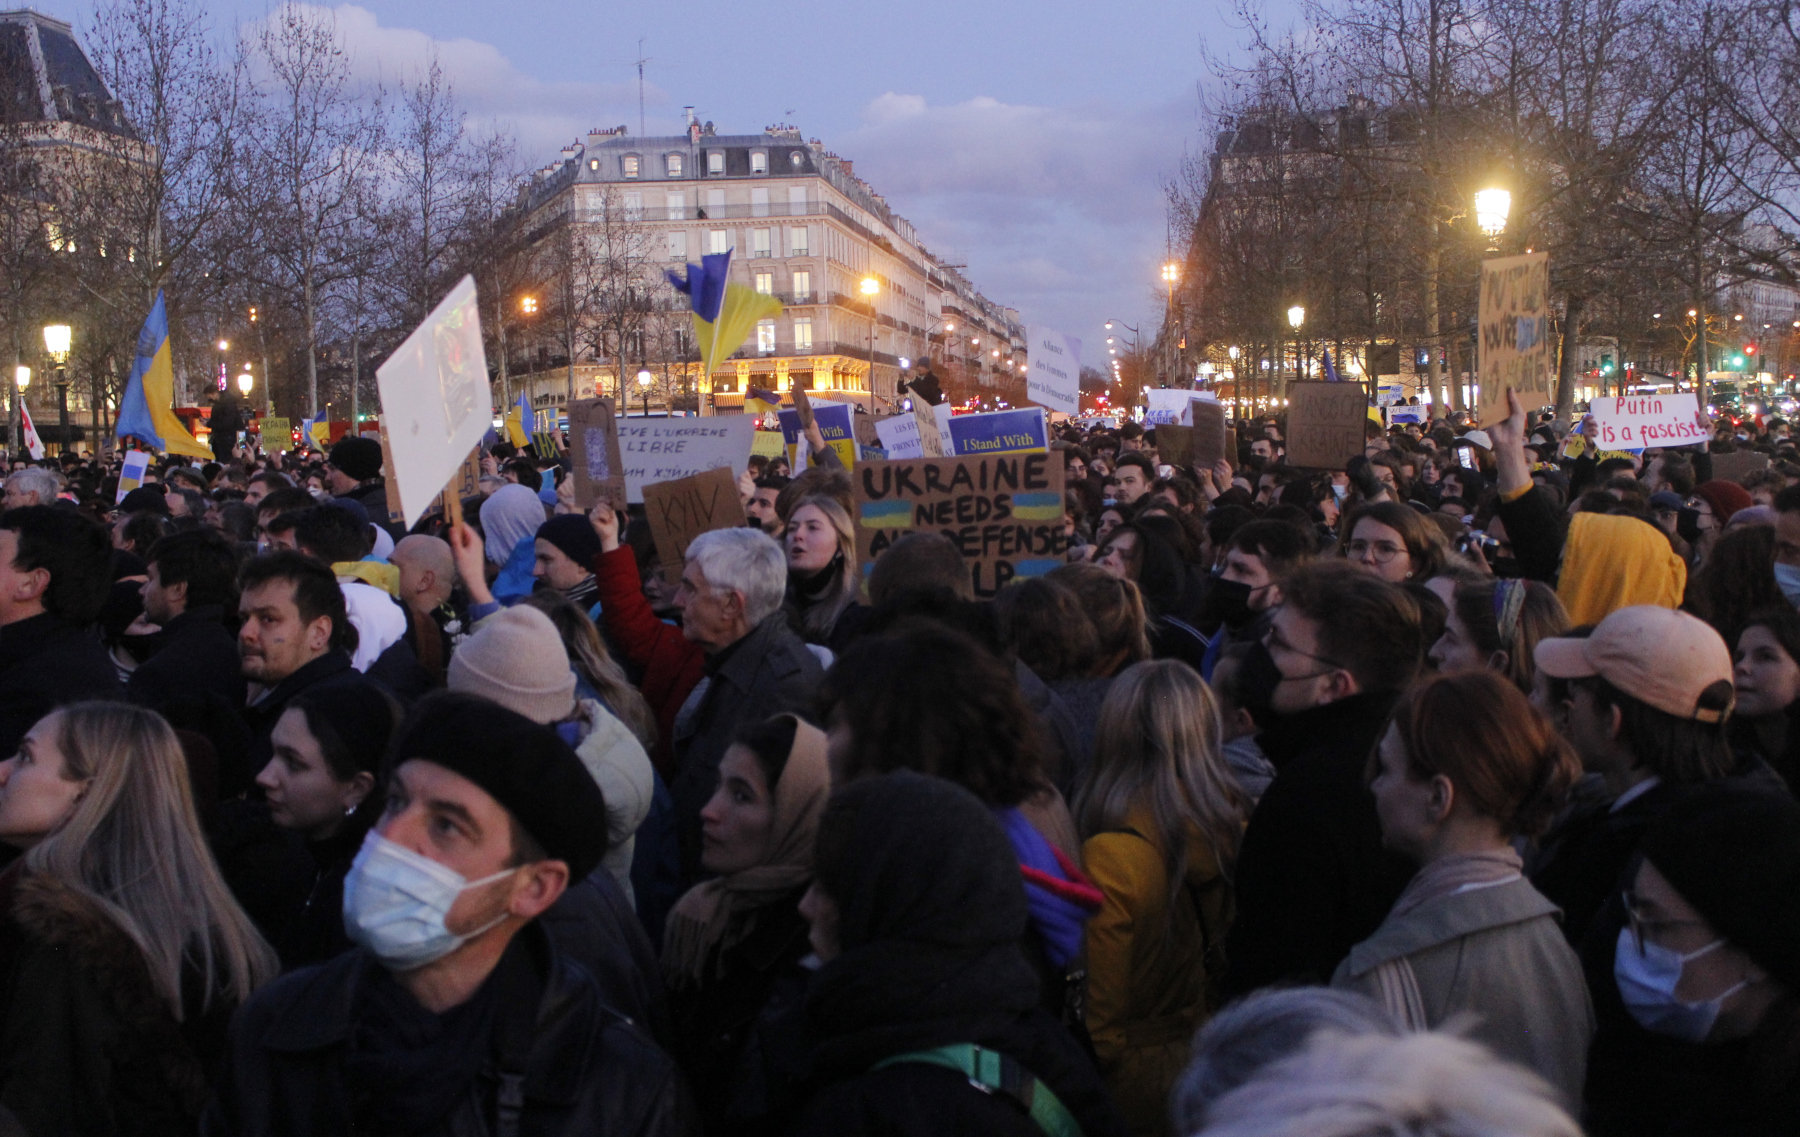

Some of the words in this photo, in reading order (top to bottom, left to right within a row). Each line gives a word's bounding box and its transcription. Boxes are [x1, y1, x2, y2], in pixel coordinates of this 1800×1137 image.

[1035, 360, 1046, 371] des
[1616, 396, 1663, 415] Putin
[618, 427, 648, 437] IVE
[654, 426, 728, 438] L'UKRAINE
[821, 425, 844, 438] With
[1602, 421, 1616, 443] is
[1621, 426, 1633, 441] a
[1640, 411, 1706, 447] fascist!
[627, 440, 688, 453] LIBRE
[892, 440, 915, 451] FRONT
[963, 439, 968, 451] I
[970, 436, 1001, 450] Stand
[1003, 433, 1034, 447] With
[862, 454, 1049, 499] UKRAINE
[658, 484, 719, 536] KYIV
[916, 494, 1011, 526] NEEDS
[869, 528, 918, 557] AI
[971, 560, 1015, 597] LP
